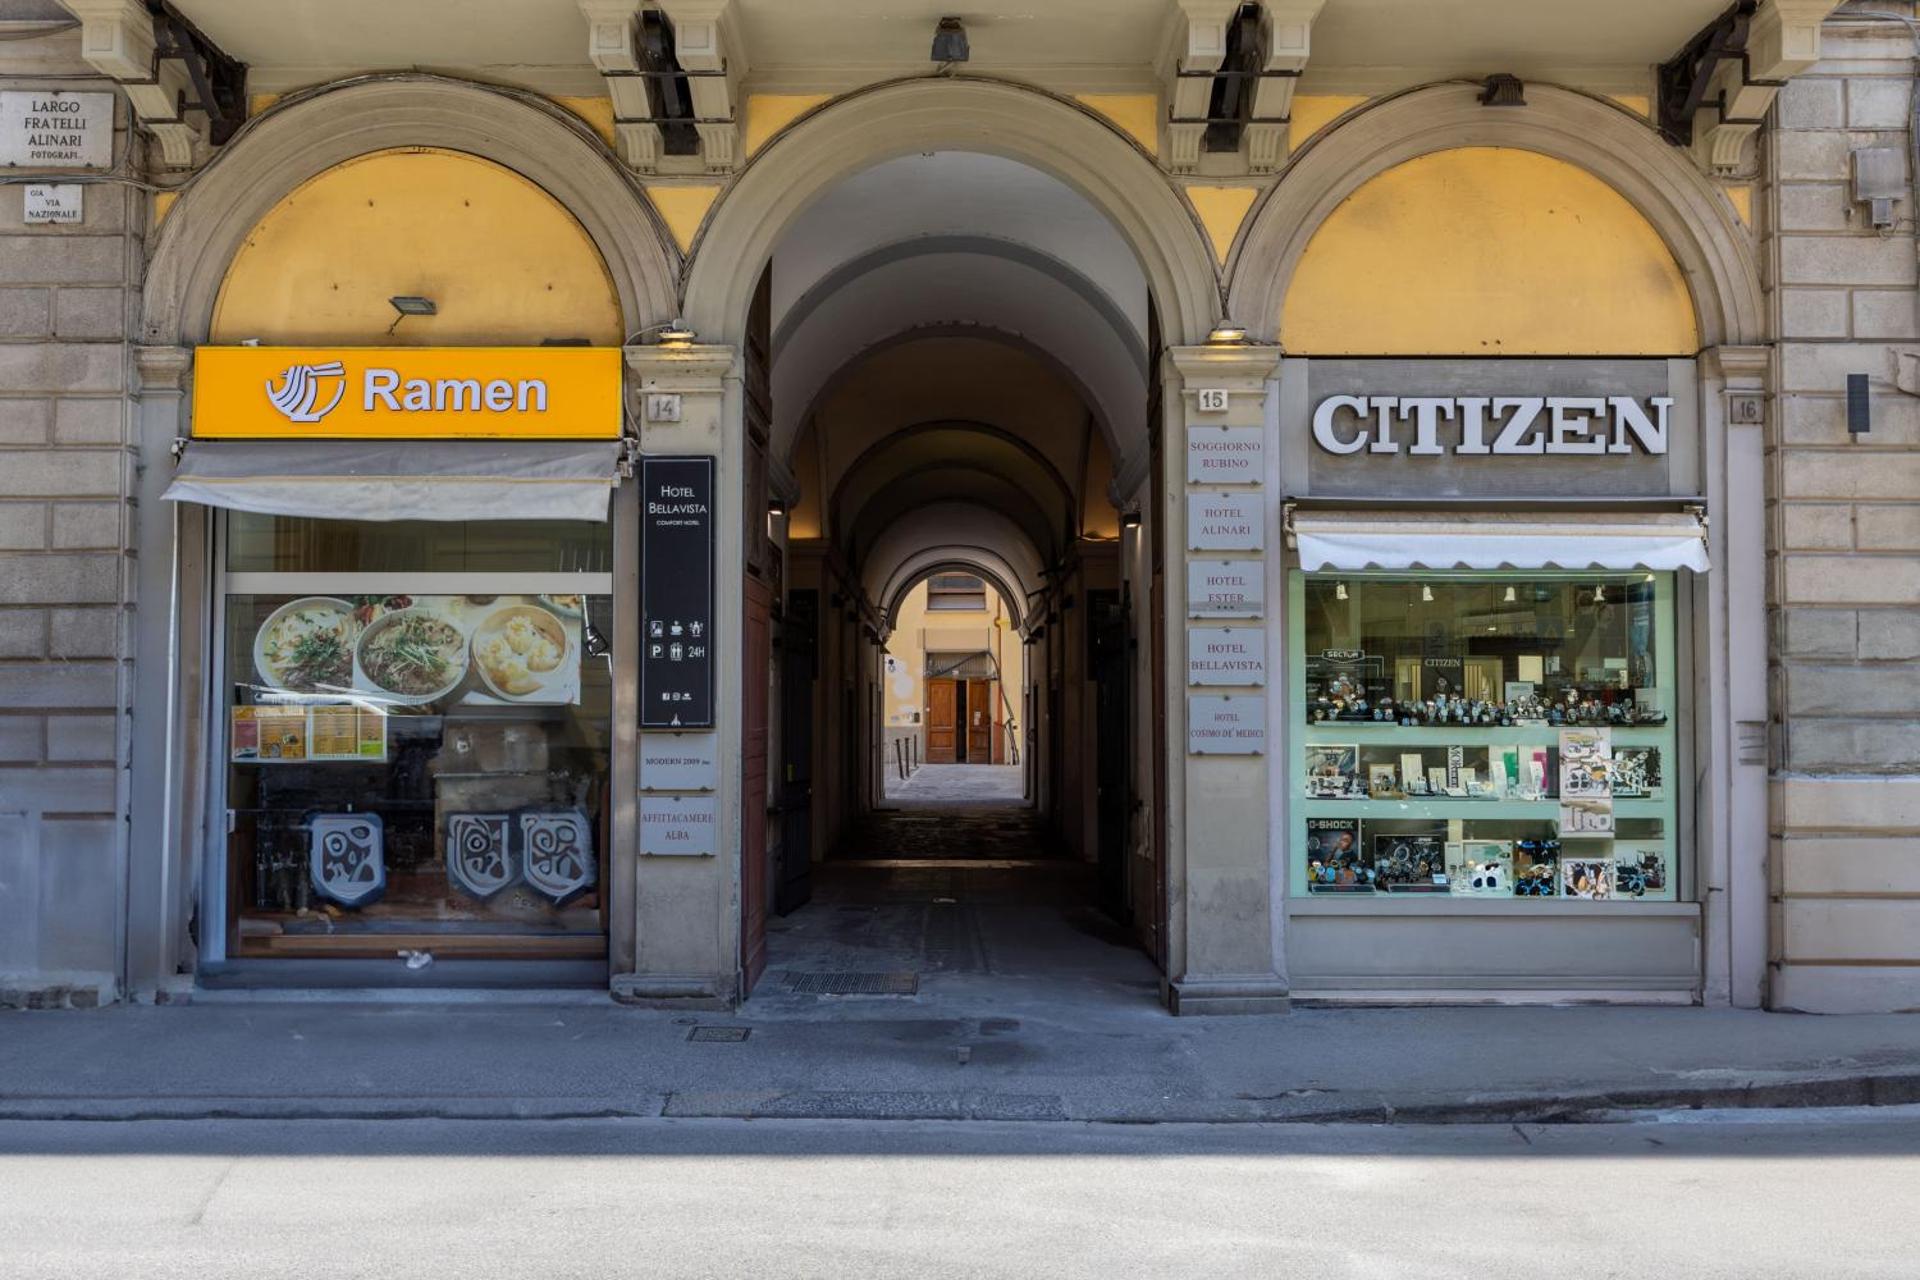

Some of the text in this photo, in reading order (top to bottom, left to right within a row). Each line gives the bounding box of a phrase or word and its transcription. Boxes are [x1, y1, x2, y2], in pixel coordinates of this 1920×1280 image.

[32, 101, 80, 113] LARGO
[24, 117, 86, 130] FRATELLI
[28, 134, 82, 147] ALINARI
[31, 151, 78, 160] FOTOGRAFI
[45, 199, 61, 207] VIA
[29, 210, 77, 218] NAZIONALE
[364, 368, 548, 412] Ramen
[1203, 391, 1223, 408] 15
[656, 399, 673, 417] 14
[1741, 400, 1757, 418] 16
[1312, 394, 1675, 455] CITIZEN
[1190, 442, 1261, 452] SOGGIORNO
[1202, 459, 1249, 468] RUBINO
[1205, 509, 1243, 518] HOTEL
[1201, 526, 1251, 535] ALINARI
[1207, 576, 1246, 586] HOTEL
[1208, 593, 1245, 603] ESTER
[688, 646, 705, 658] 24H
[1207, 644, 1246, 654] HOTEL
[1191, 661, 1263, 671] BELLAVISTA
[1424, 658, 1461, 668] CITIZEN
[1214, 713, 1240, 722] HOTEL
[1309, 820, 1354, 829] G-SHOCK
